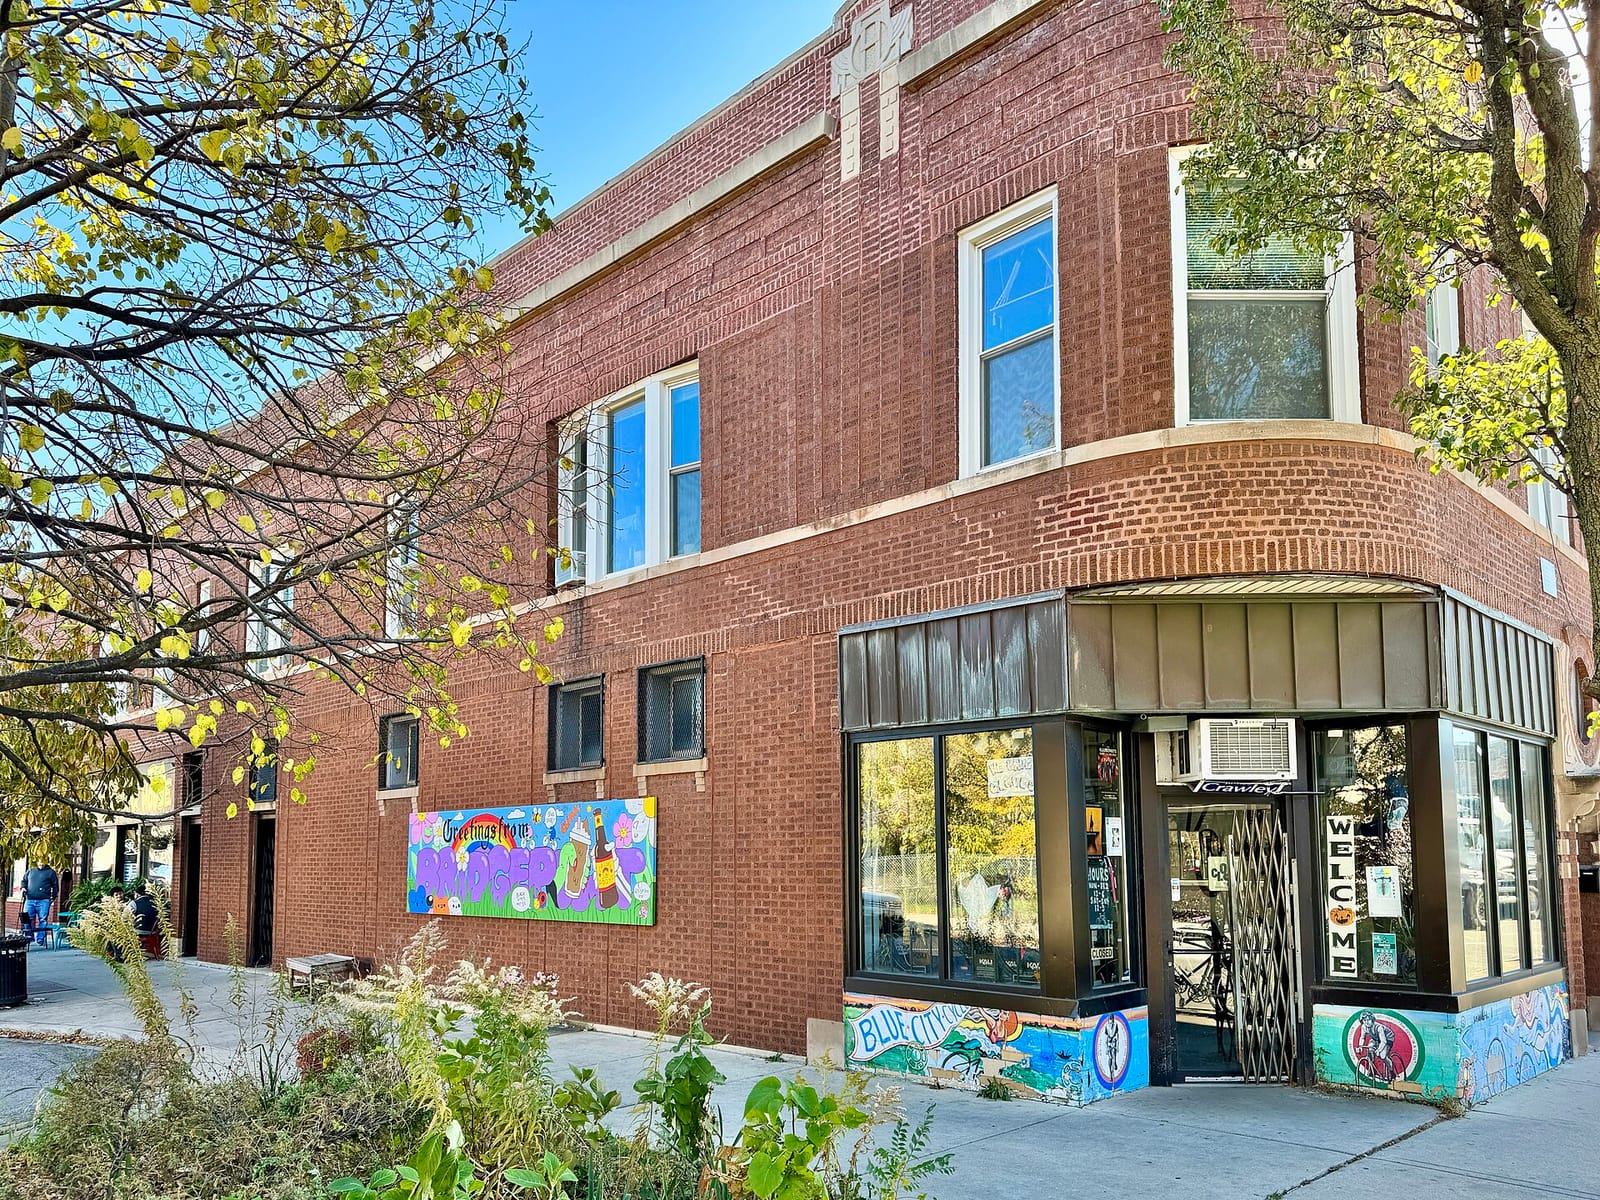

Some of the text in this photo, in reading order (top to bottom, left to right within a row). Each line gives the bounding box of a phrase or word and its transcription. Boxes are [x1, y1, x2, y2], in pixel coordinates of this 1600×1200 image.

[1202, 782, 1277, 796] Crawley
[443, 818, 497, 850] Greetings
[416, 844, 646, 912] BRIDGEPT
[1088, 867, 1109, 881] HOURS
[1091, 949, 1113, 958] CLOSED
[858, 1009, 909, 1052] BLUE
[911, 1006, 946, 1045] CITY
